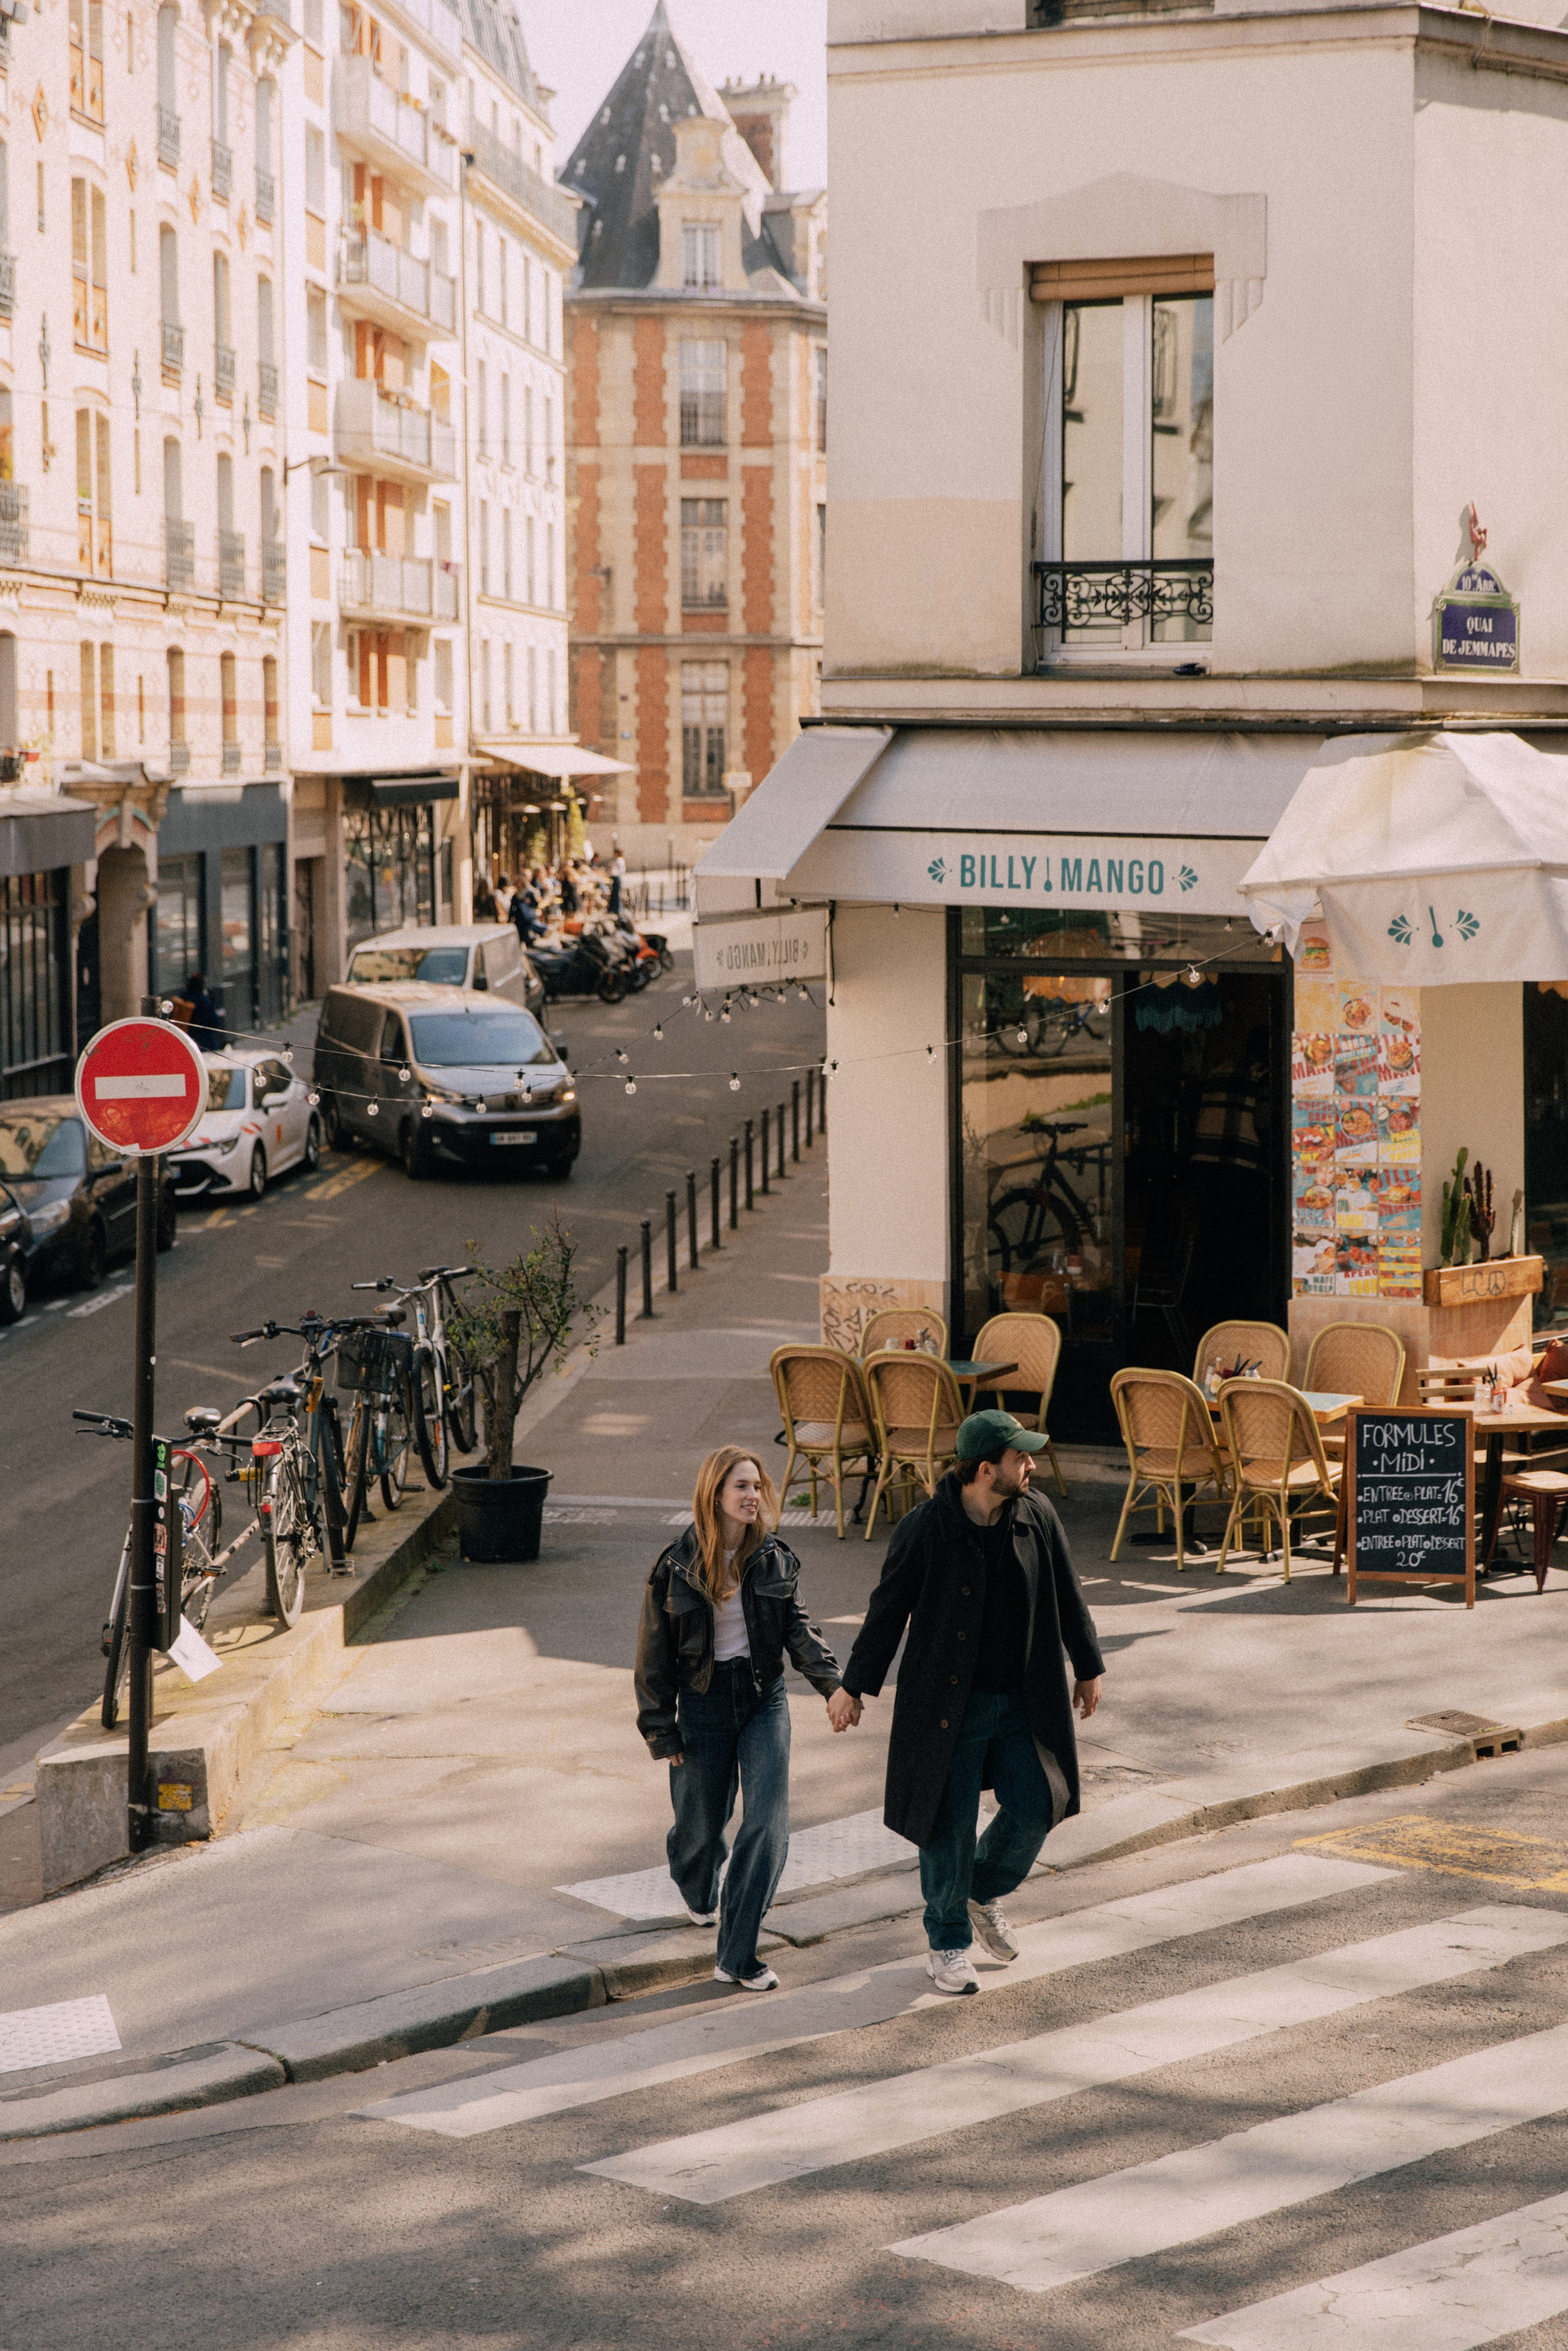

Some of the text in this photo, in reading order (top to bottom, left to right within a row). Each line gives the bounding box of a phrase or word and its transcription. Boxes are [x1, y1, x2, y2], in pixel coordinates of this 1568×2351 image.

[1466, 617, 1493, 635] QUAI
[1442, 639, 1516, 659] DE JEMMAPES
[960, 854, 1164, 895] BILLY MANGO
[1363, 1423, 1456, 1448] FORMULES
